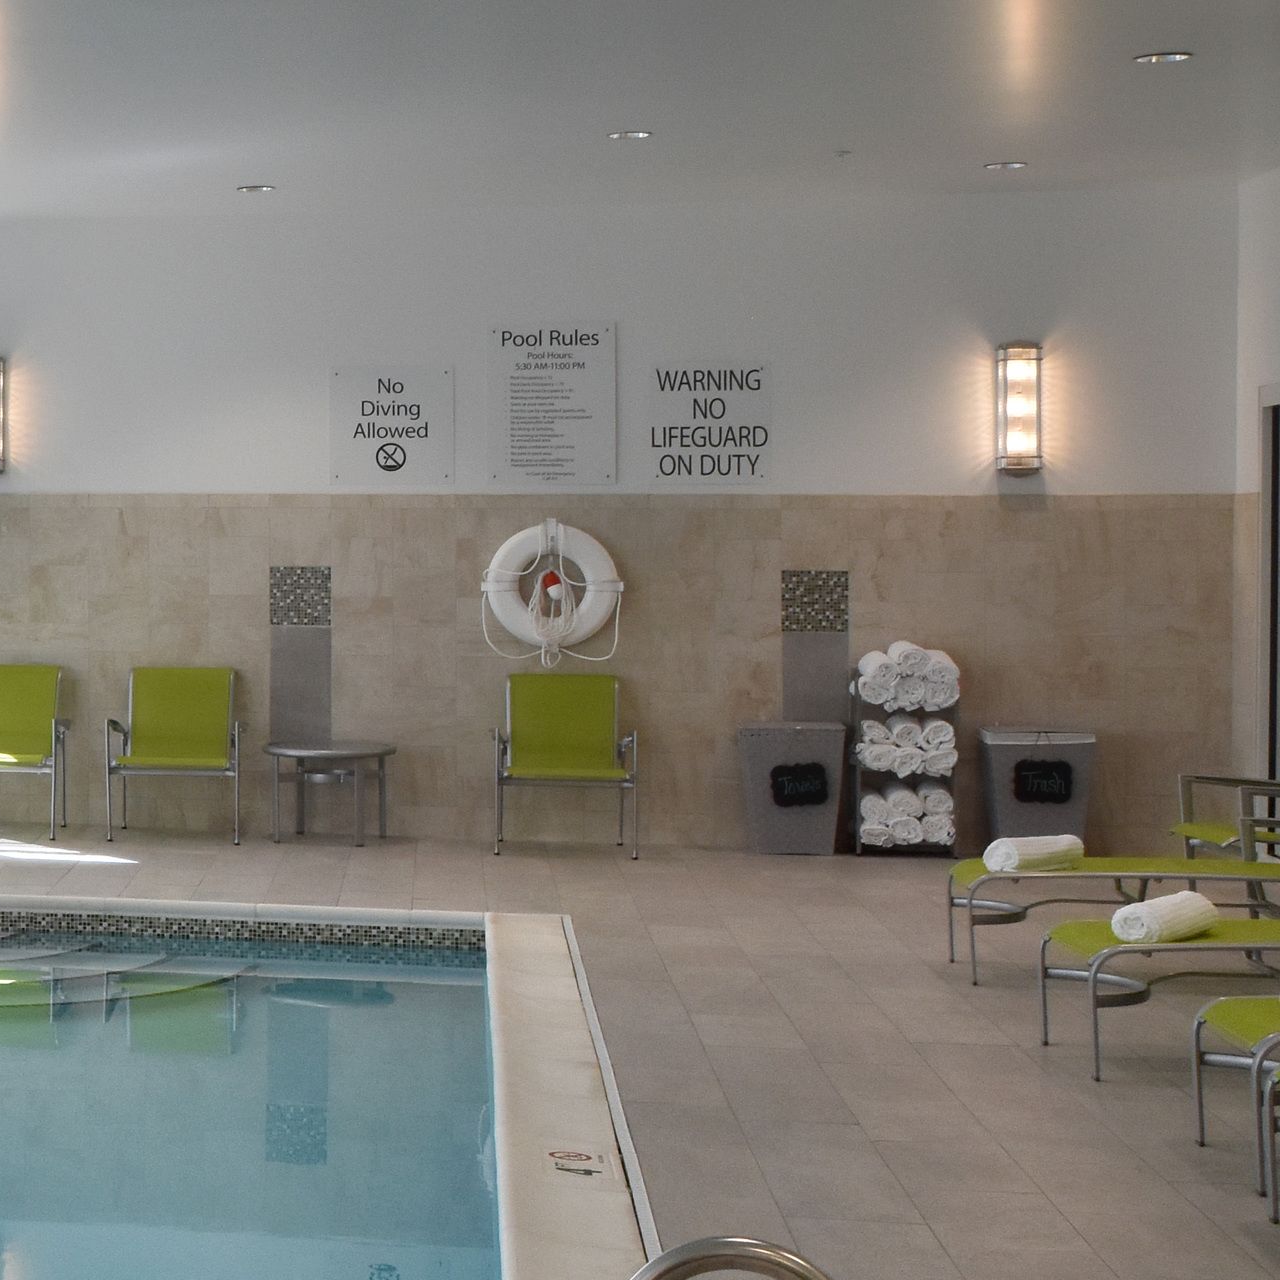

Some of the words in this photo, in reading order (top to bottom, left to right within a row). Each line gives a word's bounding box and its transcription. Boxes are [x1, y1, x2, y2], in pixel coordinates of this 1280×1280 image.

[501, 330, 542, 347] Pool
[549, 328, 600, 347] Rules
[527, 352, 545, 360] Pool
[376, 378, 405, 394] No
[655, 369, 762, 392] WARNING
[360, 400, 422, 421] Diving
[692, 397, 727, 420] NO
[352, 420, 430, 440] Allowed
[651, 425, 769, 448] LIFEGUARD
[658, 454, 692, 476] ON
[700, 453, 760, 476] DUTY
[1021, 770, 1066, 794] Trash
